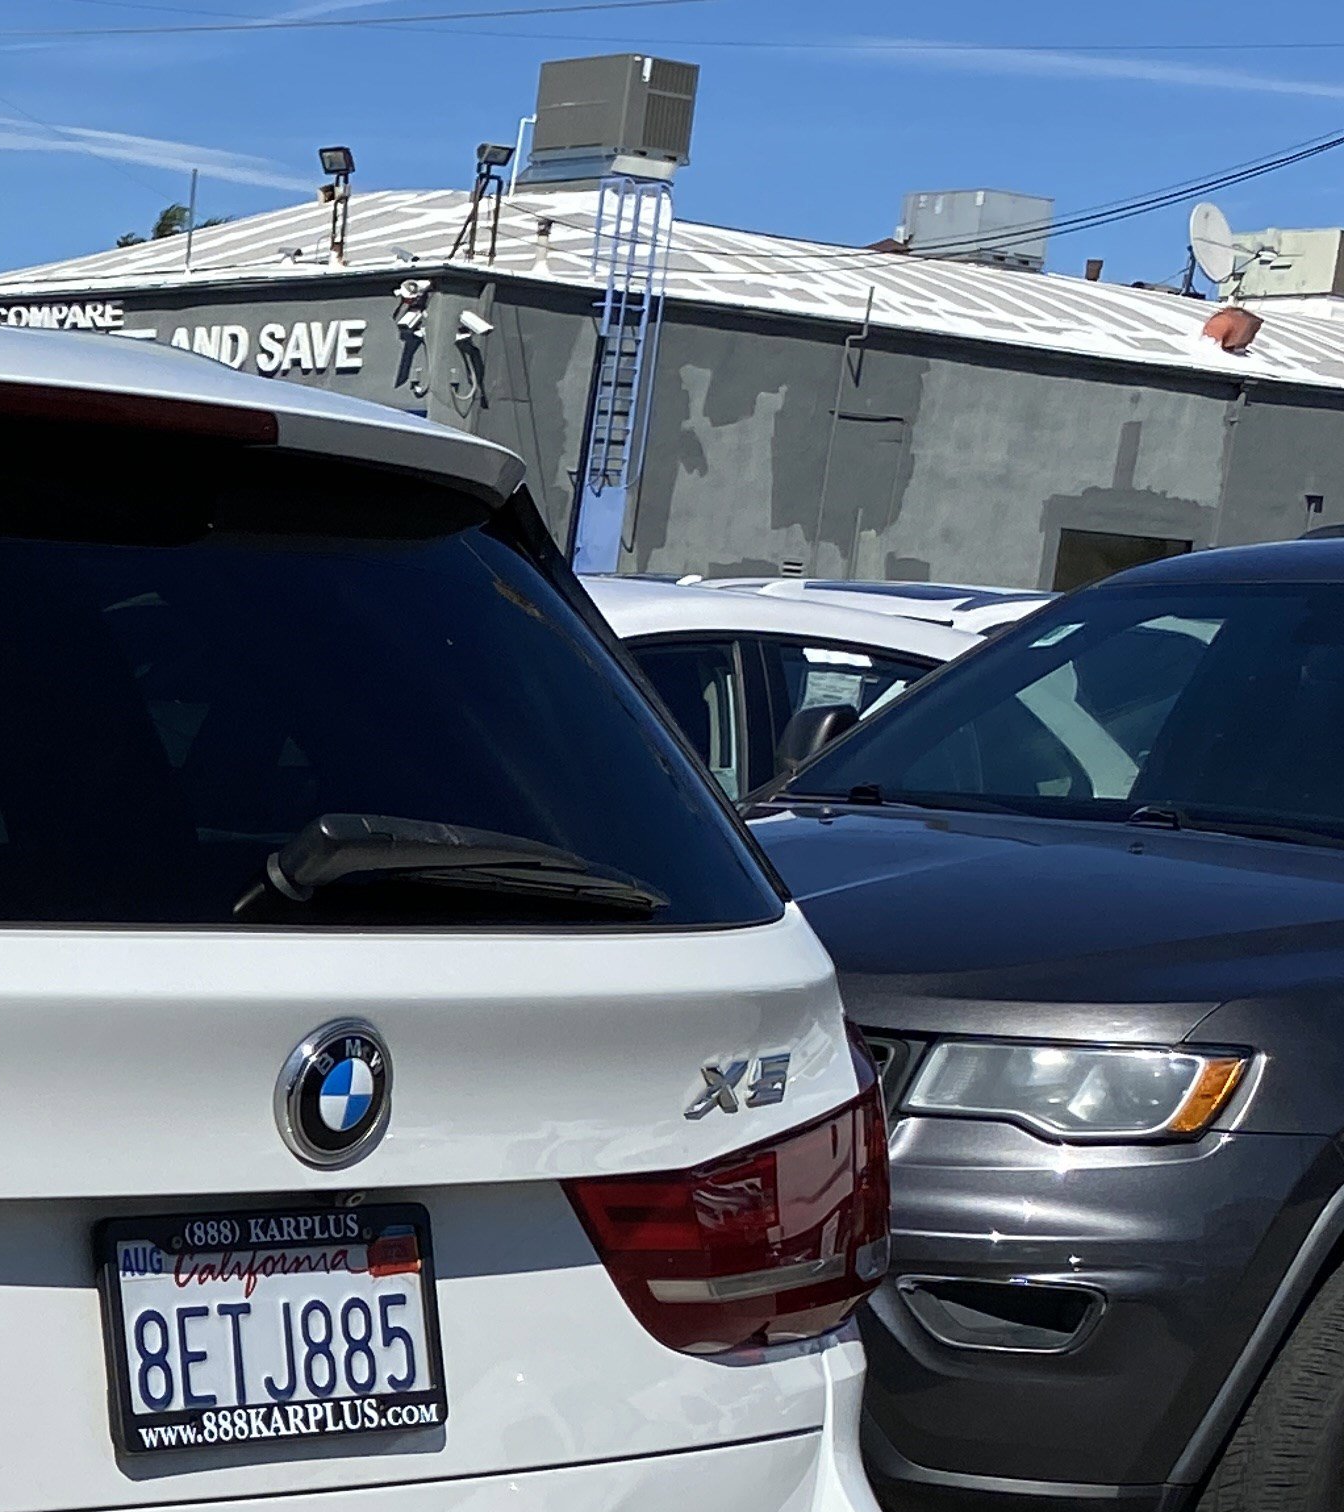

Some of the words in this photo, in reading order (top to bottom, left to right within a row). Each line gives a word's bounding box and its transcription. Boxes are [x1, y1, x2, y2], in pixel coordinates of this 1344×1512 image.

[170, 325, 250, 369] AND
[256, 319, 367, 373] SAVE
[313, 1039, 384, 1076] BMW
[683, 1052, 791, 1120] X5
[185, 1219, 240, 1246] (888)
[248, 1213, 360, 1243] KARPLUS
[121, 1247, 163, 1277] AUG
[173, 1248, 368, 1299] California
[134, 1293, 417, 1412] 8ETJ885
